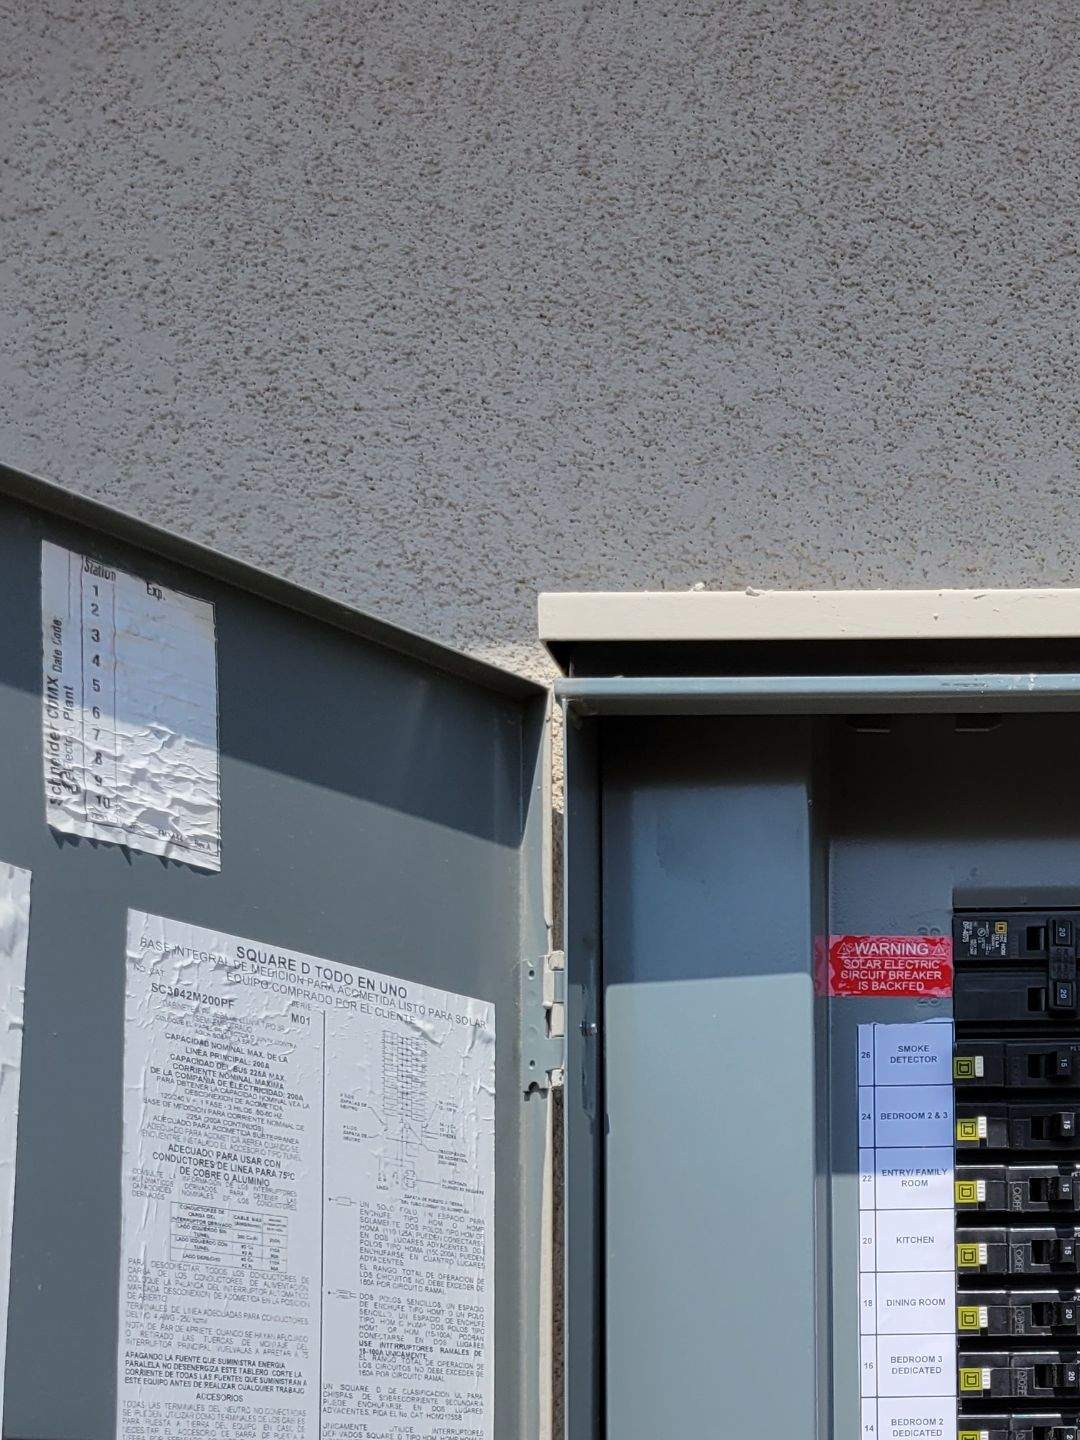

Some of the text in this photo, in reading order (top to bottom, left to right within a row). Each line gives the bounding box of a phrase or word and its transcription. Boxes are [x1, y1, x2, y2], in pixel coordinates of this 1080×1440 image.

[93, 585, 98, 596] 1
[91, 603, 99, 616] 2
[92, 629, 99, 642] 3
[92, 655, 100, 666] 4
[92, 679, 100, 692] 5
[93, 707, 100, 719] 6
[855, 943, 929, 955] WARNING
[844, 959, 940, 969] SOLAR ELECTRIC
[237, 946, 407, 999] SQUARE D TODO EN UNO
[842, 971, 942, 979] CIRCUIT BREAKER
[858, 982, 924, 991] IS BACKFED
[898, 1045, 929, 1053] SMOKE
[890, 1056, 937, 1064] DETECTOR
[880, 1112, 925, 1120] BEDROOM
[897, 1236, 935, 1244] KITCHEN
[891, 1418, 937, 1426] BEDROOM
